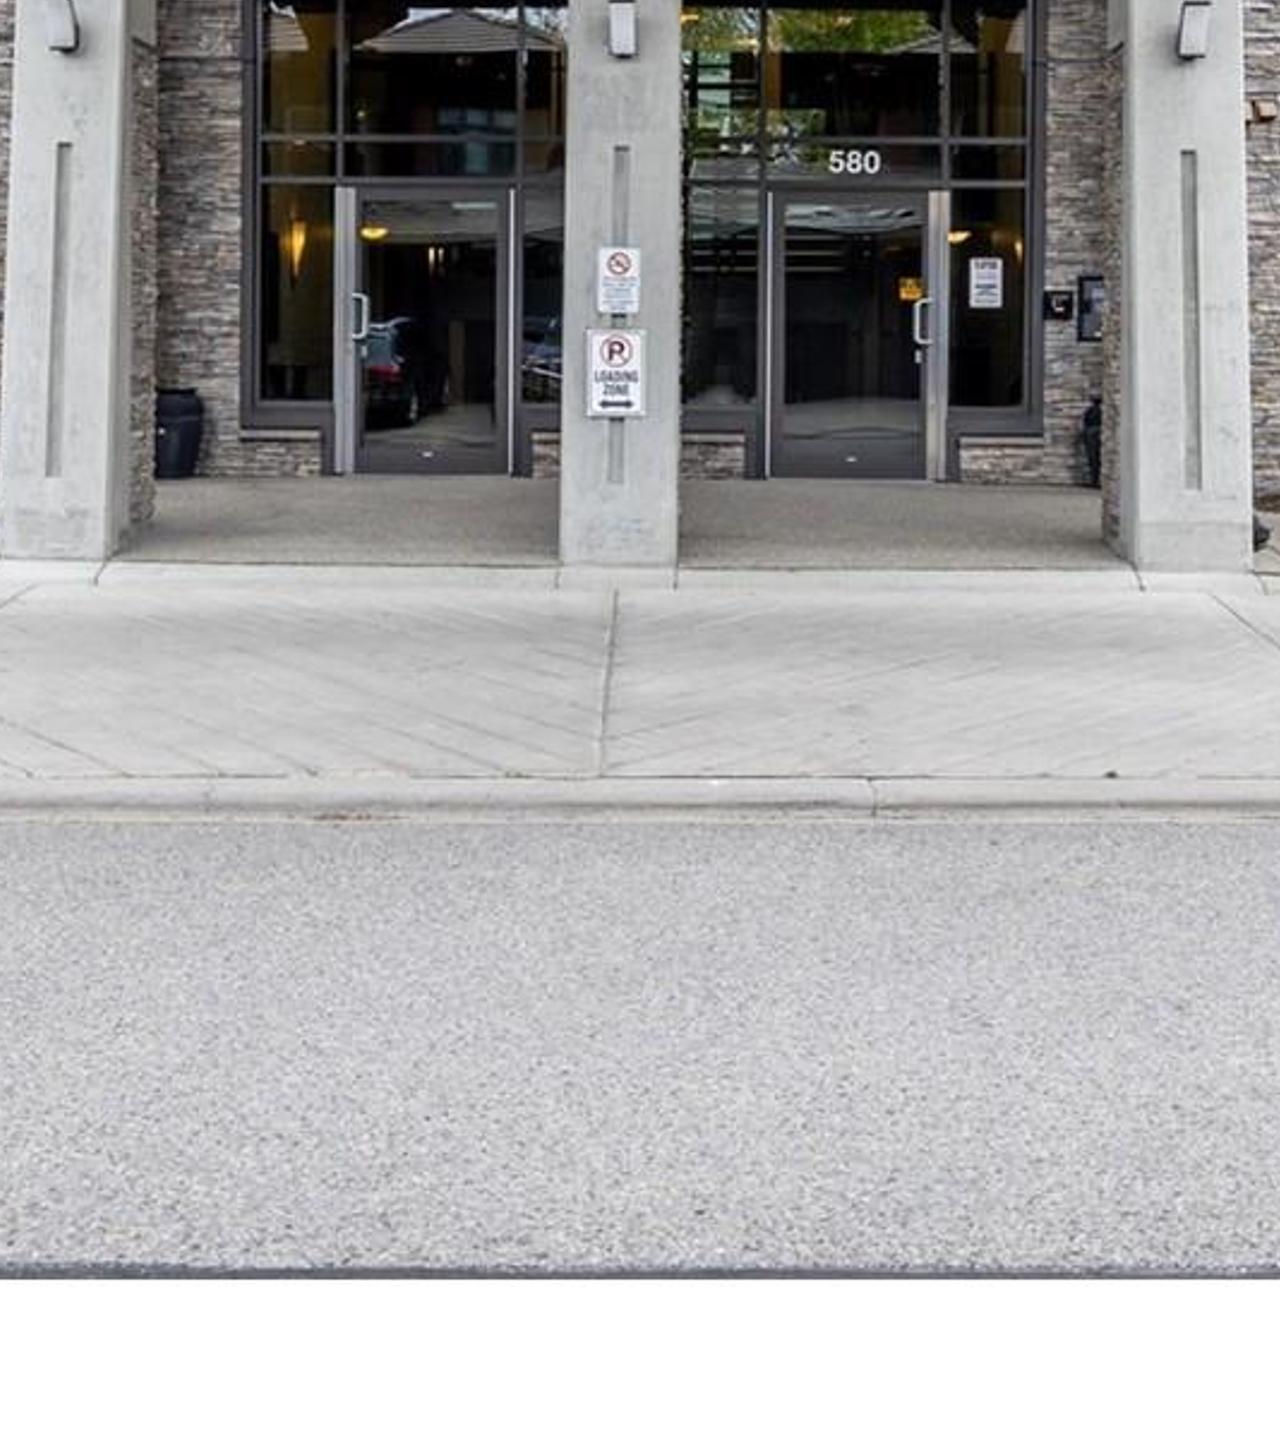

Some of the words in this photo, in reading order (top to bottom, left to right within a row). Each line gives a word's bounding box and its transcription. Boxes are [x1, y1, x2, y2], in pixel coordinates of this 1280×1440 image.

[828, 150, 881, 174] 580
[608, 340, 625, 361] P
[594, 370, 638, 383] LOADING
[602, 383, 629, 396] ZONE
